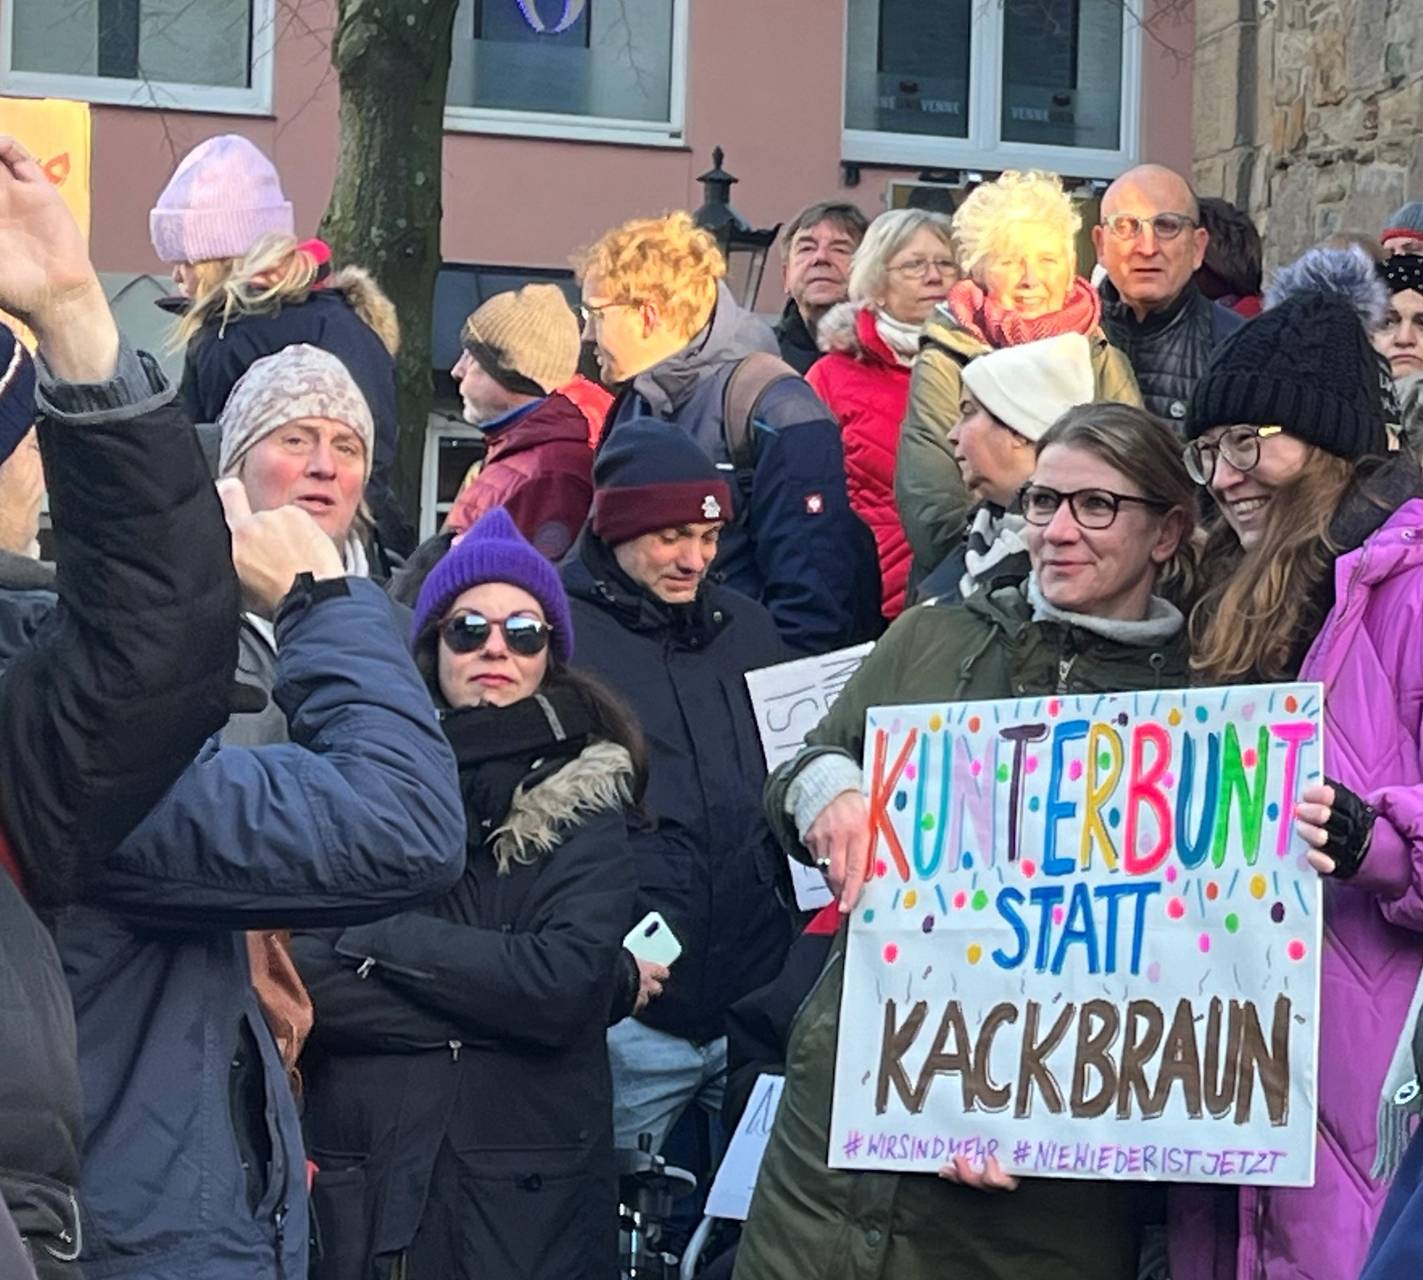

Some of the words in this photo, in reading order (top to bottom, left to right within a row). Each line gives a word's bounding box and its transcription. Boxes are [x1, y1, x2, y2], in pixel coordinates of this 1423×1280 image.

[864, 718, 1320, 883] KUNTERBUNT
[991, 881, 1162, 976] STATT
[875, 993, 1292, 1127] KACKBRAUN
